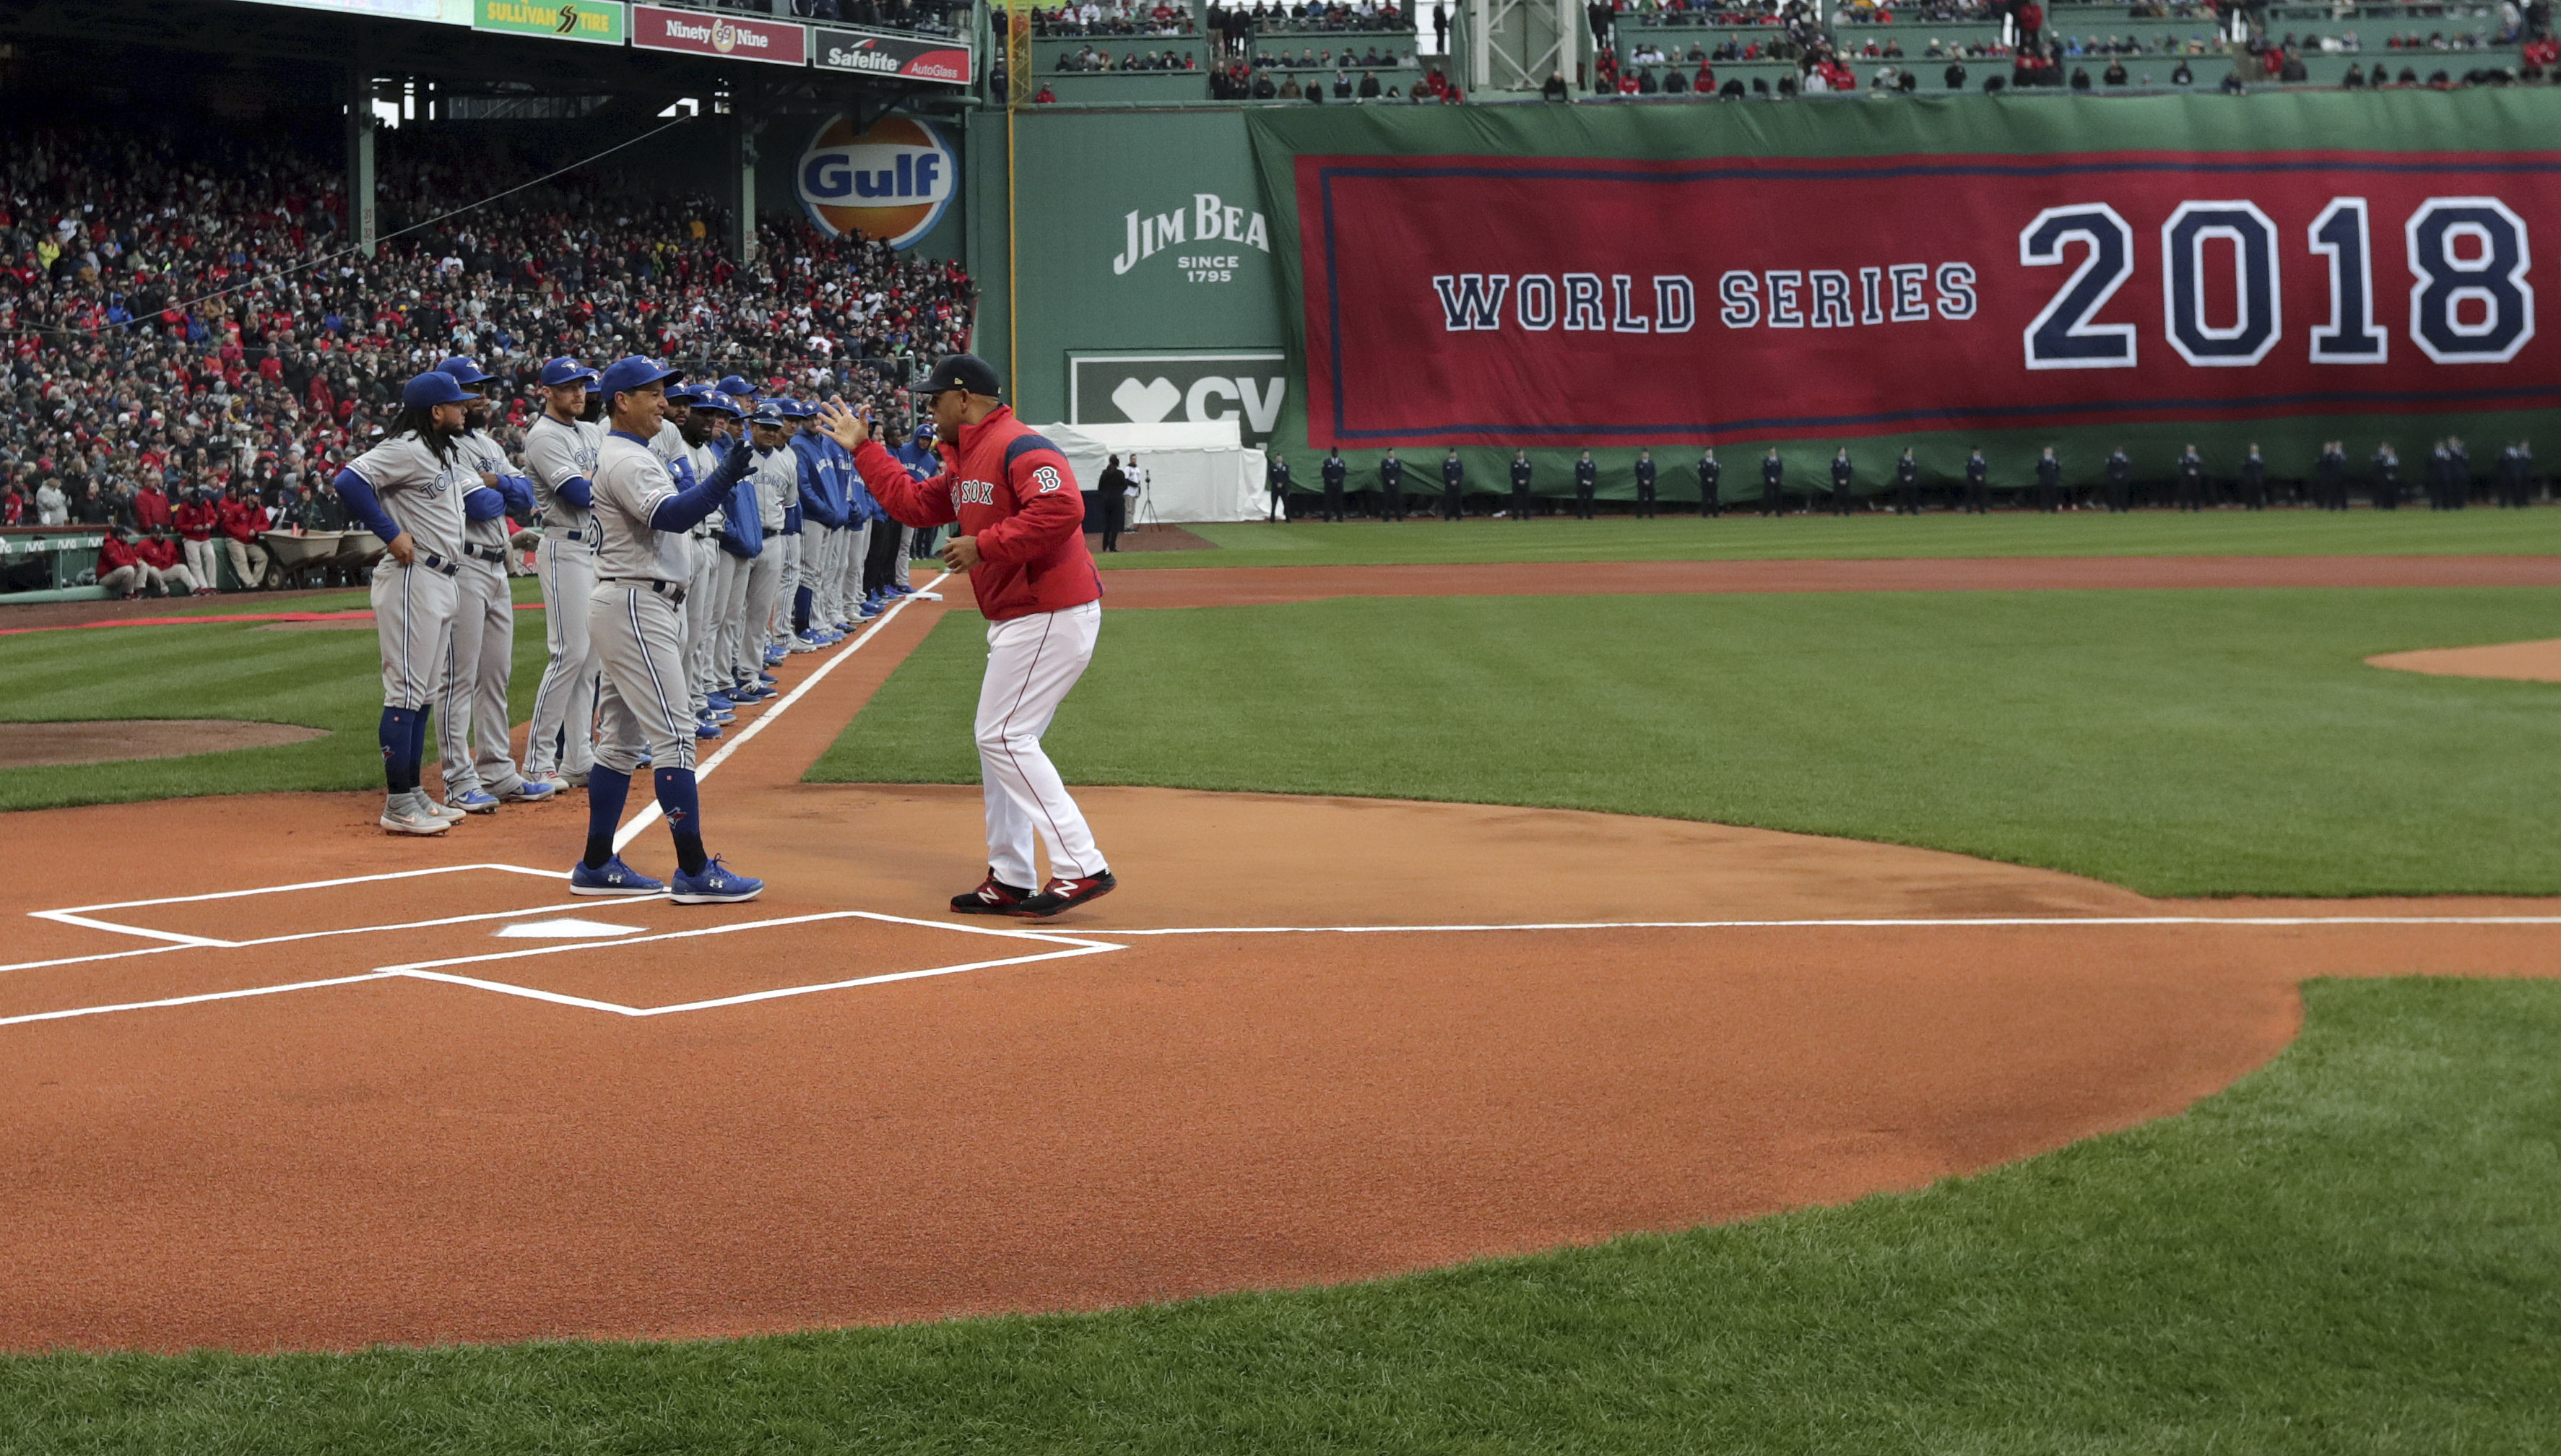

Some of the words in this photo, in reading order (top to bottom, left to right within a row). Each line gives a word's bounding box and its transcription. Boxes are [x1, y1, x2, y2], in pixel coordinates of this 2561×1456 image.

[488, 1, 558, 26] SULLIVAN
[580, 12, 610, 32] TIRE
[666, 20, 711, 44] Ninety
[737, 28, 768, 48] Nine
[828, 47, 898, 72] Safelite
[911, 62, 958, 79] AutoGlass
[805, 153, 940, 199] Gulf
[1113, 207, 1187, 275] JIM
[1193, 193, 1271, 254] BEA
[1178, 256, 1239, 268] SINCE
[1187, 270, 1231, 282] 1795
[2019, 196, 2535, 370] 2018
[1433, 273, 1695, 334] WORLD
[1718, 261, 1977, 329] SERIES
[1185, 376, 1286, 433] CV
[961, 480, 994, 505] SOX
[1033, 466, 1061, 493] B
